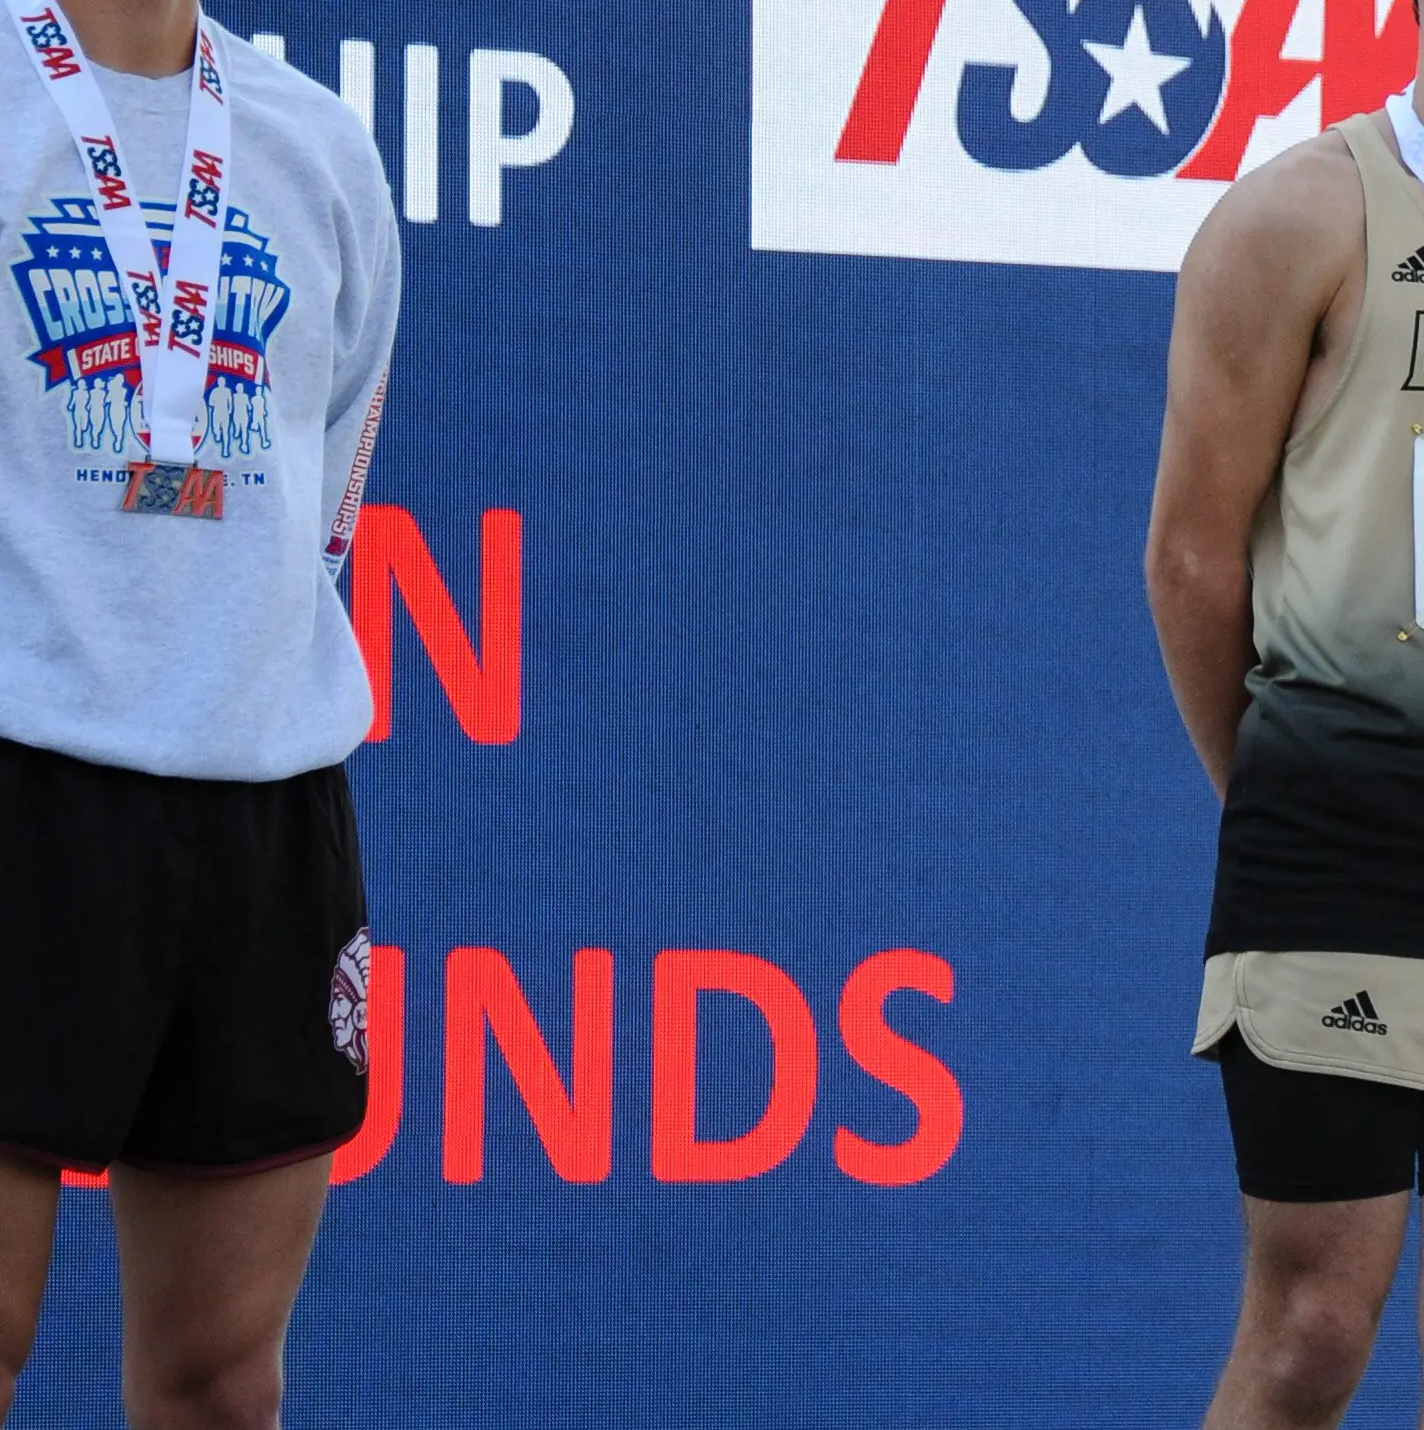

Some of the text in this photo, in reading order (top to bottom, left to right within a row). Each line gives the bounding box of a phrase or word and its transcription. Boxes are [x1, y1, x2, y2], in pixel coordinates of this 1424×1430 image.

[80, 135, 132, 211] TSSAA
[185, 149, 224, 230] TSSAA
[167, 280, 209, 359] TSSAA
[81, 338, 130, 371] STATE
[242, 473, 265, 486] TN
[1321, 1014, 1388, 1036] adidas
